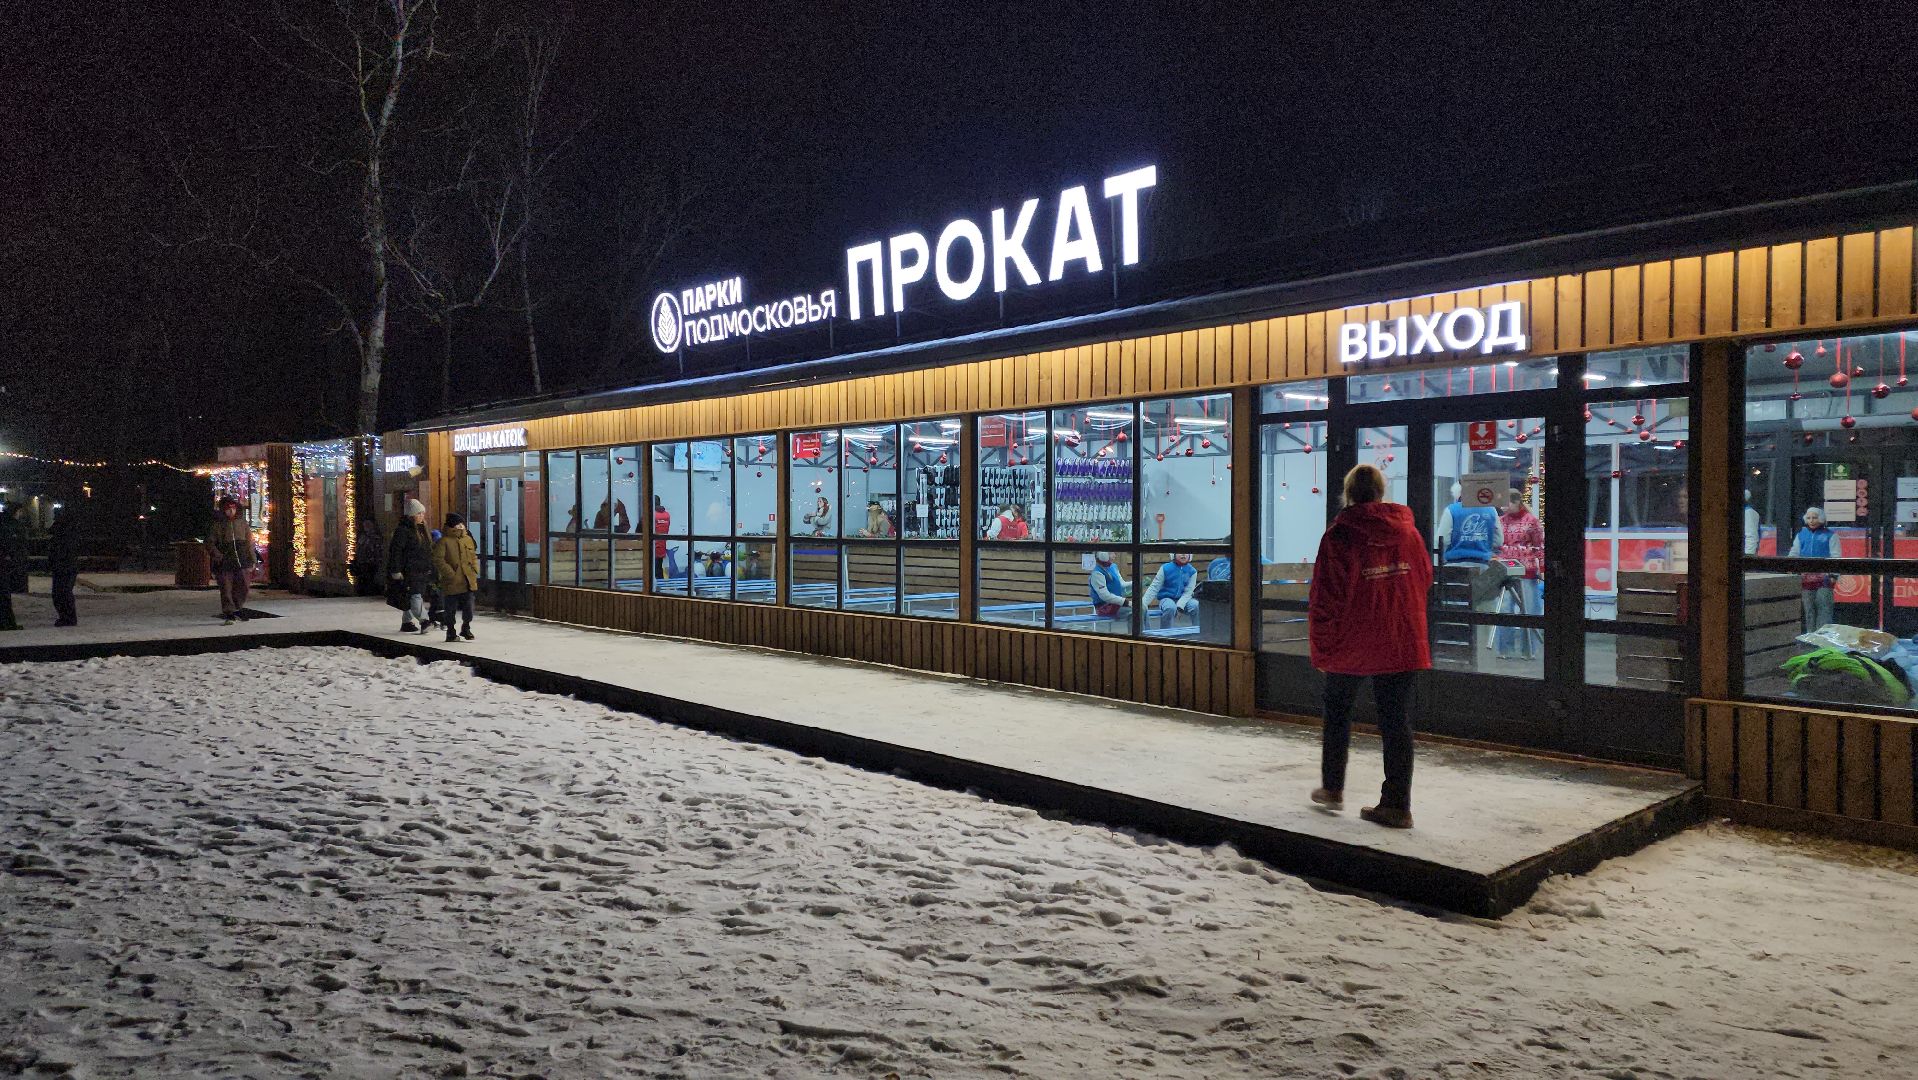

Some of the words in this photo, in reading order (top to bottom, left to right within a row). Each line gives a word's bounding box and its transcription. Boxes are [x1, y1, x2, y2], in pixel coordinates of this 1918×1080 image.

[846, 164, 1157, 321] ПРОКАТ
[682, 276, 743, 316] ПАРКИ
[684, 289, 837, 347] ПОДМОСКОВЬЯ
[1339, 301, 1526, 363] ВЫХОД
[454, 433, 480, 453] ВХОД
[478, 431, 493, 450] НА
[493, 427, 526, 447] КАТОК
